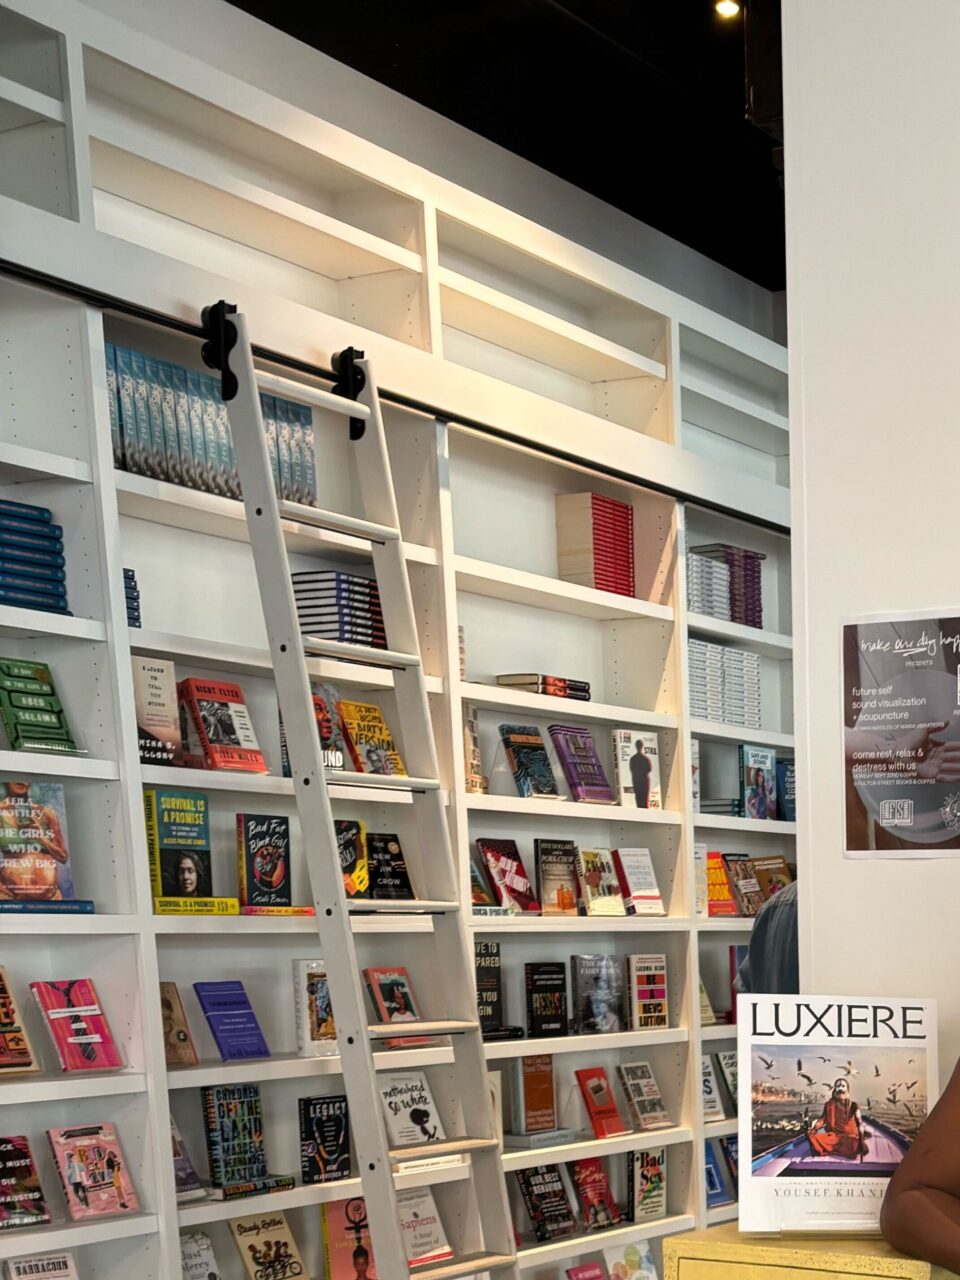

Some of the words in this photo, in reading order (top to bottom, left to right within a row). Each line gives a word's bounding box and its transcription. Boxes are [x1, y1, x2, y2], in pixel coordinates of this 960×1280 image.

[862, 640, 890, 651] make
[852, 688, 876, 696] future
[878, 685, 892, 695] self
[852, 700, 876, 708] sound
[878, 697, 926, 708] visualization
[859, 712, 909, 721] acupuncture
[896, 748, 915, 757] relax
[853, 763, 886, 771] destress
[888, 762, 905, 770] with
[161, 798, 195, 810] SURVIVAL
[197, 799, 204, 811] IS
[164, 811, 169, 822] A
[171, 813, 204, 824] PROMISE
[19, 828, 54, 838] GIRLS
[248, 821, 266, 838] Bad
[270, 819, 286, 832] Fat
[8, 844, 40, 853] WHO
[35, 860, 56, 868] BIG
[483, 992, 497, 1001] YOU
[639, 1016, 666, 1026] LUTION
[751, 1003, 927, 1039] LUXIERE
[216, 1087, 258, 1100] CHILDREN
[310, 1103, 346, 1116] LEGACY
[640, 1150, 665, 1168] Bad
[641, 1170, 663, 1184] Sex
[774, 1188, 830, 1197] YOUSEF
[400, 1216, 437, 1231] Sapiens
